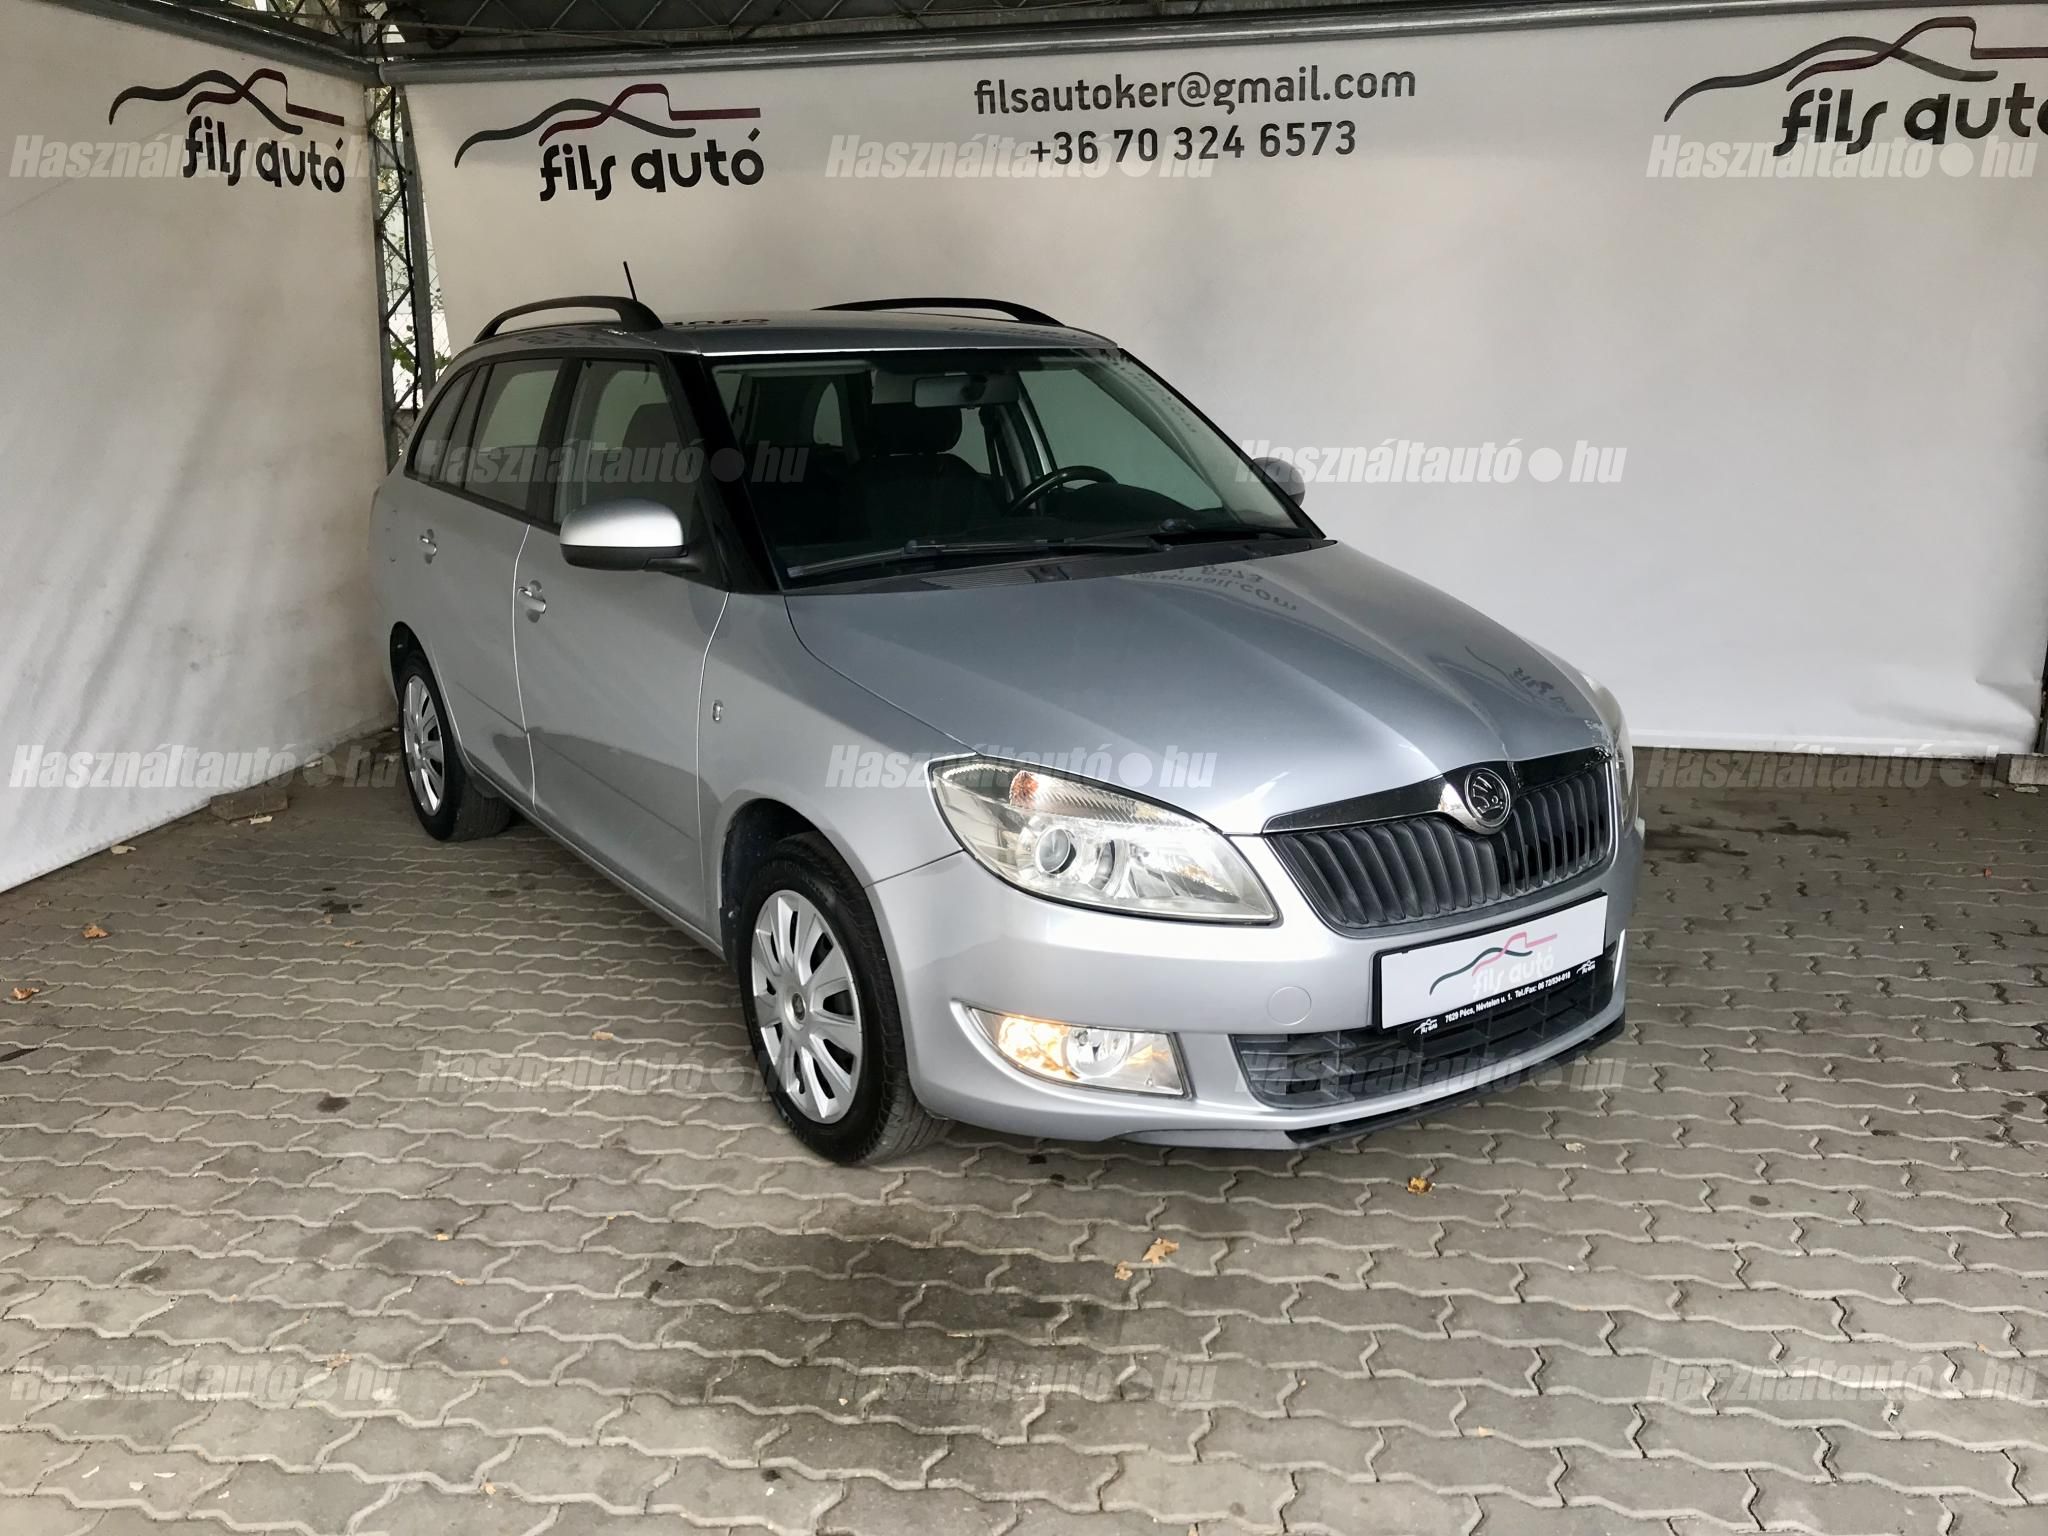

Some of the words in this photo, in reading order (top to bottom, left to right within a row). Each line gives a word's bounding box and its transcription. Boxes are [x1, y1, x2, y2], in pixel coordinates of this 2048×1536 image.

[975, 66, 1416, 114] filsautoker@gmail.com
[1773, 87, 1888, 157] fils
[182, 115, 248, 187] fils
[257, 137, 346, 194] autó
[540, 143, 616, 200] fils
[631, 128, 764, 194] autó
[1030, 131, 1099, 165] +36
[1114, 129, 1159, 163] 70
[1173, 125, 1245, 160] 324
[1260, 120, 1357, 157] 6573
